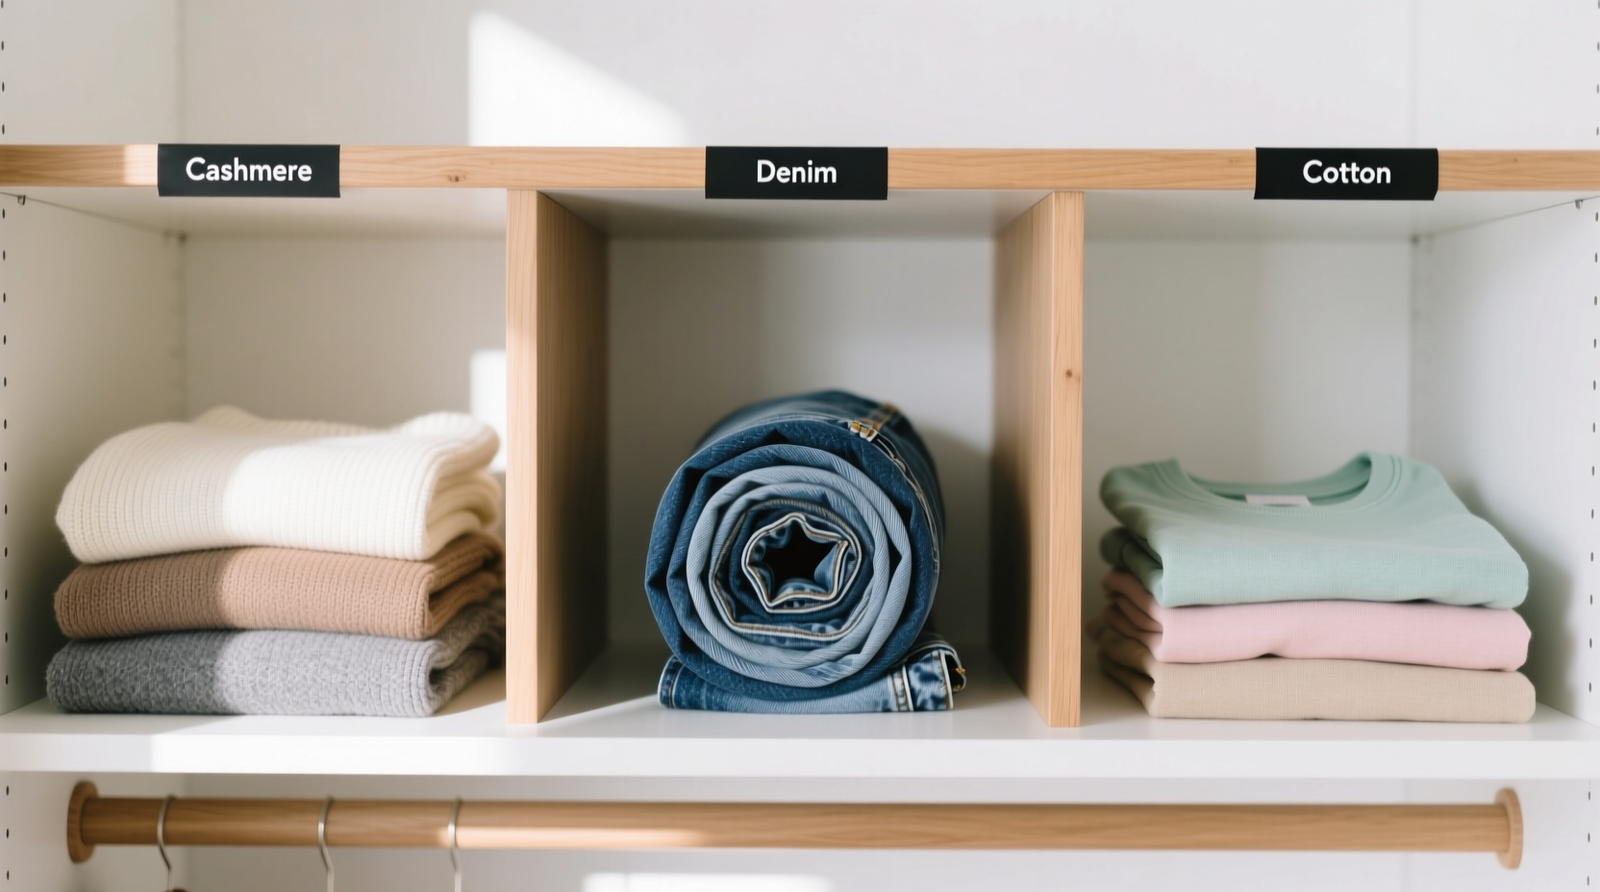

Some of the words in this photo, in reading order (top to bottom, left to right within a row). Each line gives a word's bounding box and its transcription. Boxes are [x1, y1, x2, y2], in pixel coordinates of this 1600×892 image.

[185, 156, 313, 182] Cashmere
[756, 159, 837, 184] Denim
[1302, 159, 1392, 184] Cotton
